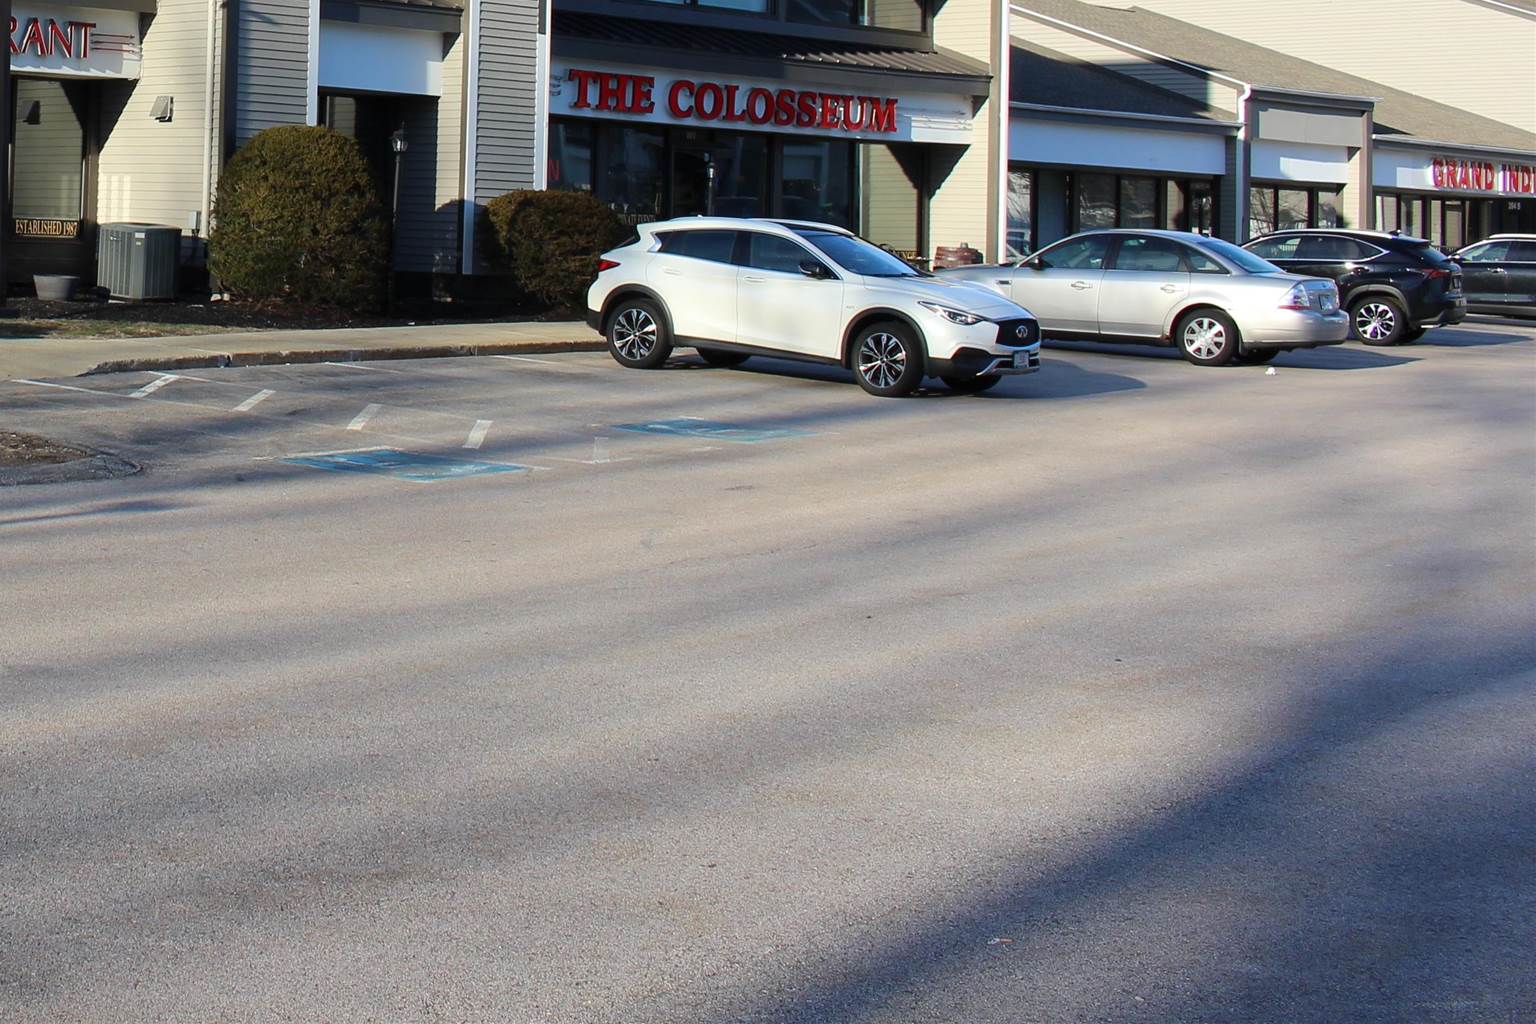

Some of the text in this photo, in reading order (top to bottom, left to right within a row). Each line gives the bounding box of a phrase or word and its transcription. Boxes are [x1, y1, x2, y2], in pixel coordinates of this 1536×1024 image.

[568, 68, 898, 132] THE COLOSSEUM
[1432, 158, 1495, 190] GRAND
[15, 219, 62, 235] ESTABLISHED
[63, 222, 78, 236] 1987
